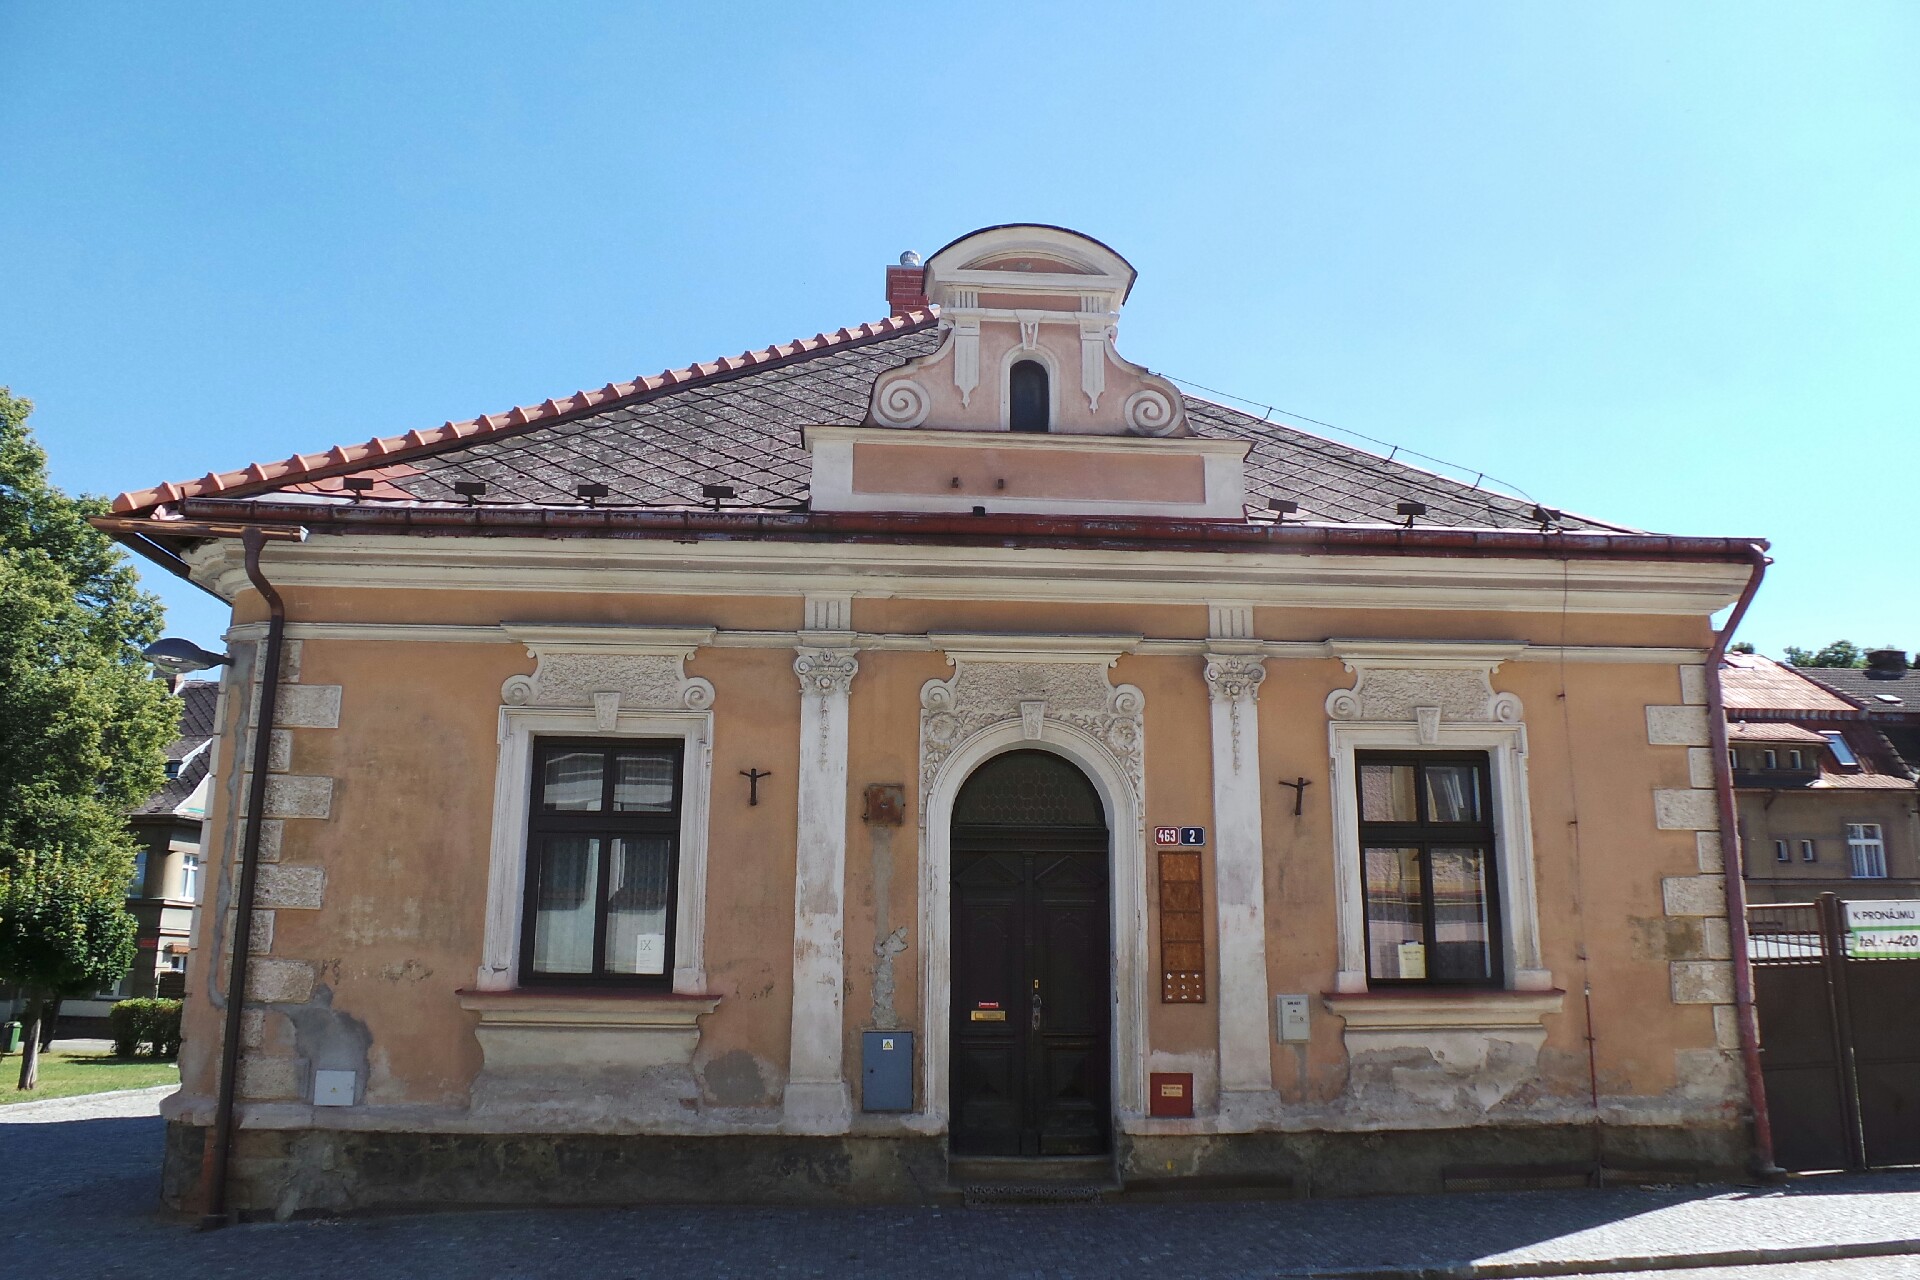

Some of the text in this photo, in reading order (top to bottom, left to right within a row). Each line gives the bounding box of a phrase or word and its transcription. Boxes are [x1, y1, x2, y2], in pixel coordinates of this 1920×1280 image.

[1158, 829, 1176, 842] 463
[1189, 829, 1196, 843] 2
[1853, 911, 1860, 920] K
[1887, 934, 1919, 947] +420
